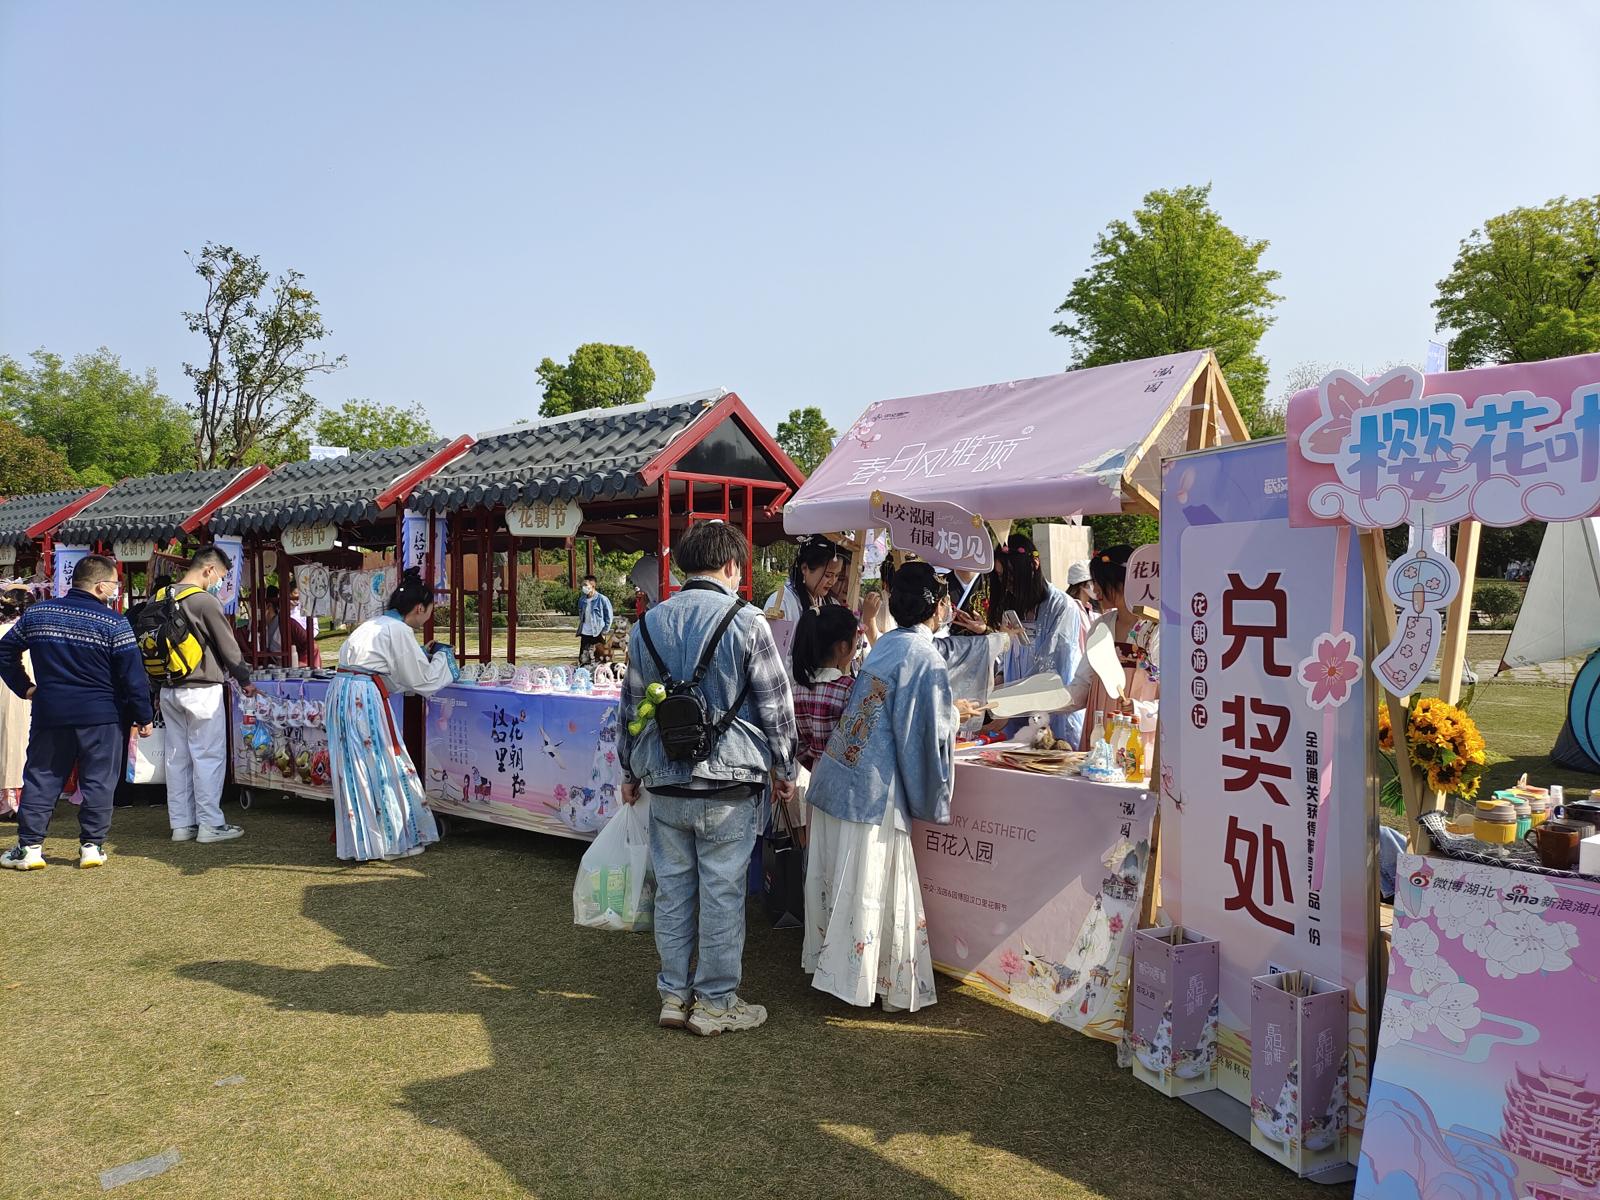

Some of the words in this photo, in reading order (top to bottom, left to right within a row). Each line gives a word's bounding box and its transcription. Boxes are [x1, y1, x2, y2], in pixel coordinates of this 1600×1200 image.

[518, 503, 567, 529] 花朝节
[882, 501, 935, 528] 中交·泓园
[290, 524, 326, 547] 花朝节
[935, 527, 986, 565] 相见
[1191, 592, 1208, 730] 花朝游园记
[491, 704, 509, 773] 汉口里
[1221, 571, 1296, 936] 兑奖处
[971, 819, 1037, 842] AESTHETIC
[925, 829, 994, 864] 百花入园
[1432, 877, 1496, 898] 微博湖北
